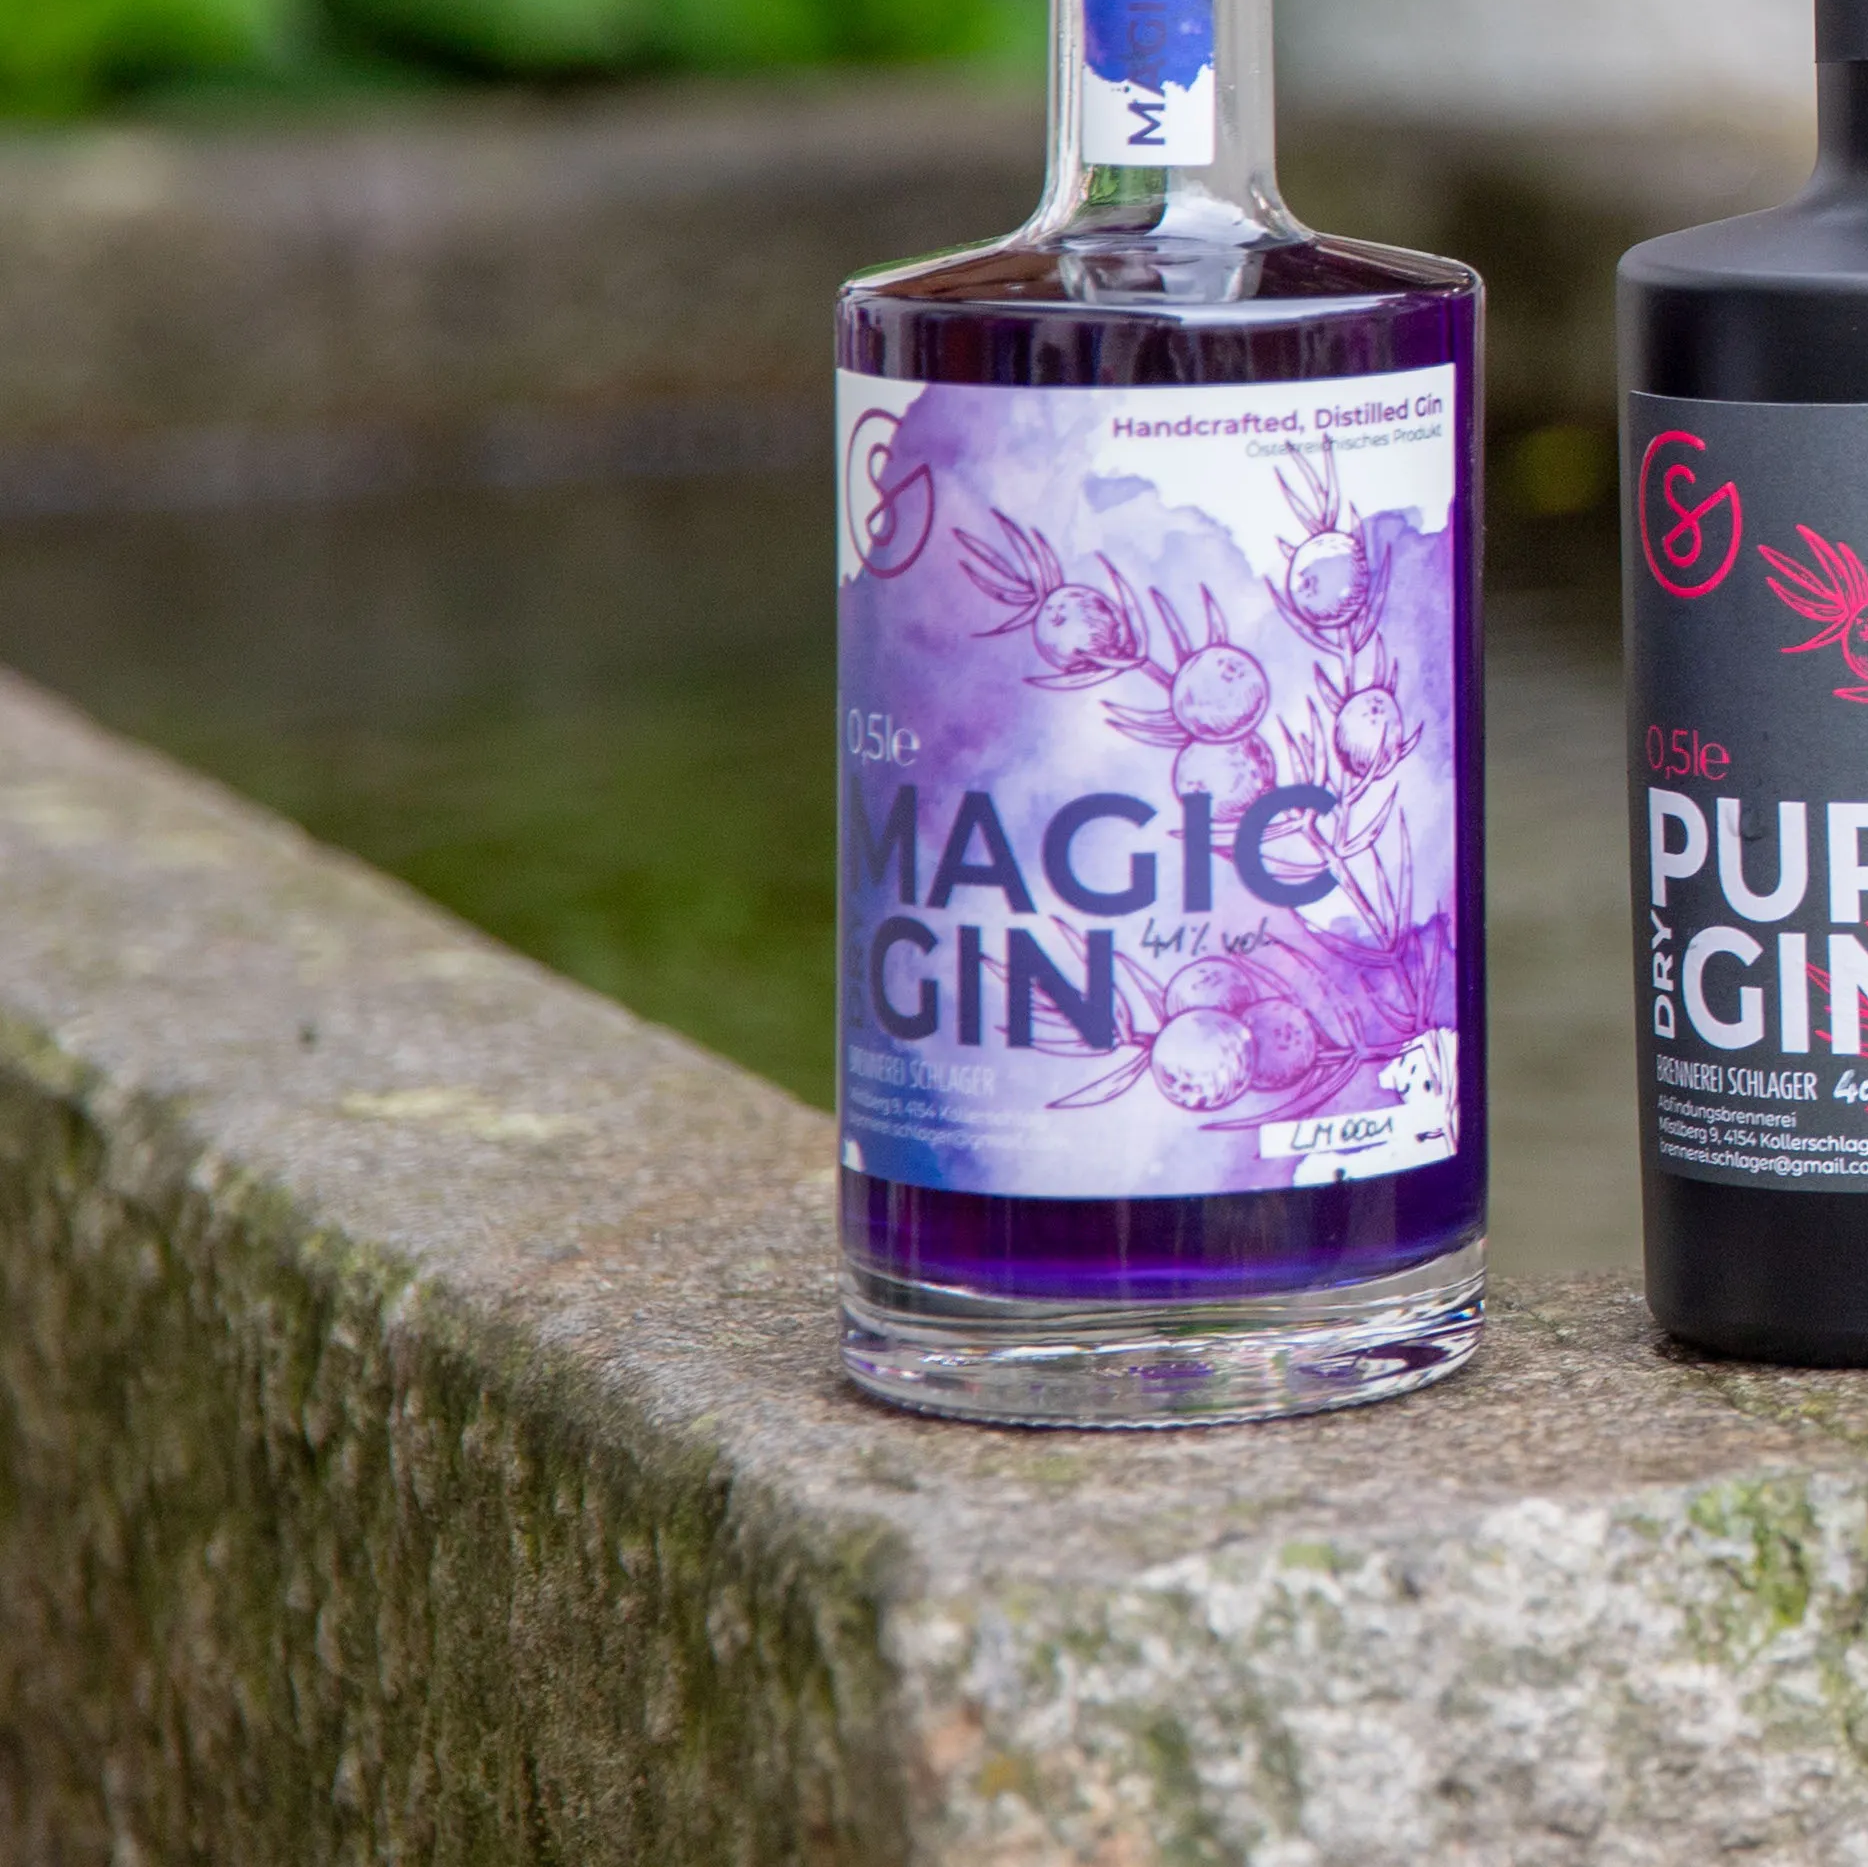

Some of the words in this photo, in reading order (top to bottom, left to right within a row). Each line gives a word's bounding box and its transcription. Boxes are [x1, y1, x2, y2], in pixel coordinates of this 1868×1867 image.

[1112, 409, 1305, 438] Handcrafted,
[1315, 397, 1410, 430] Distilled
[1415, 393, 1444, 418] Gin
[1393, 422, 1444, 443] Produkt
[849, 775, 1339, 917] MAGIC
[870, 915, 1115, 1050] GIN
[1650, 909, 1676, 1040] DRY
[1656, 1054, 1724, 1094] BRENNEREI
[1727, 1068, 1818, 1101] SCHLAGER
[1657, 1094, 1797, 1129] Abfindungsbrennerei
[1658, 1115, 1707, 1145] Mistlberg
[1709, 1127, 1722, 1146] 9,
[1723, 1129, 1758, 1148] 4154
